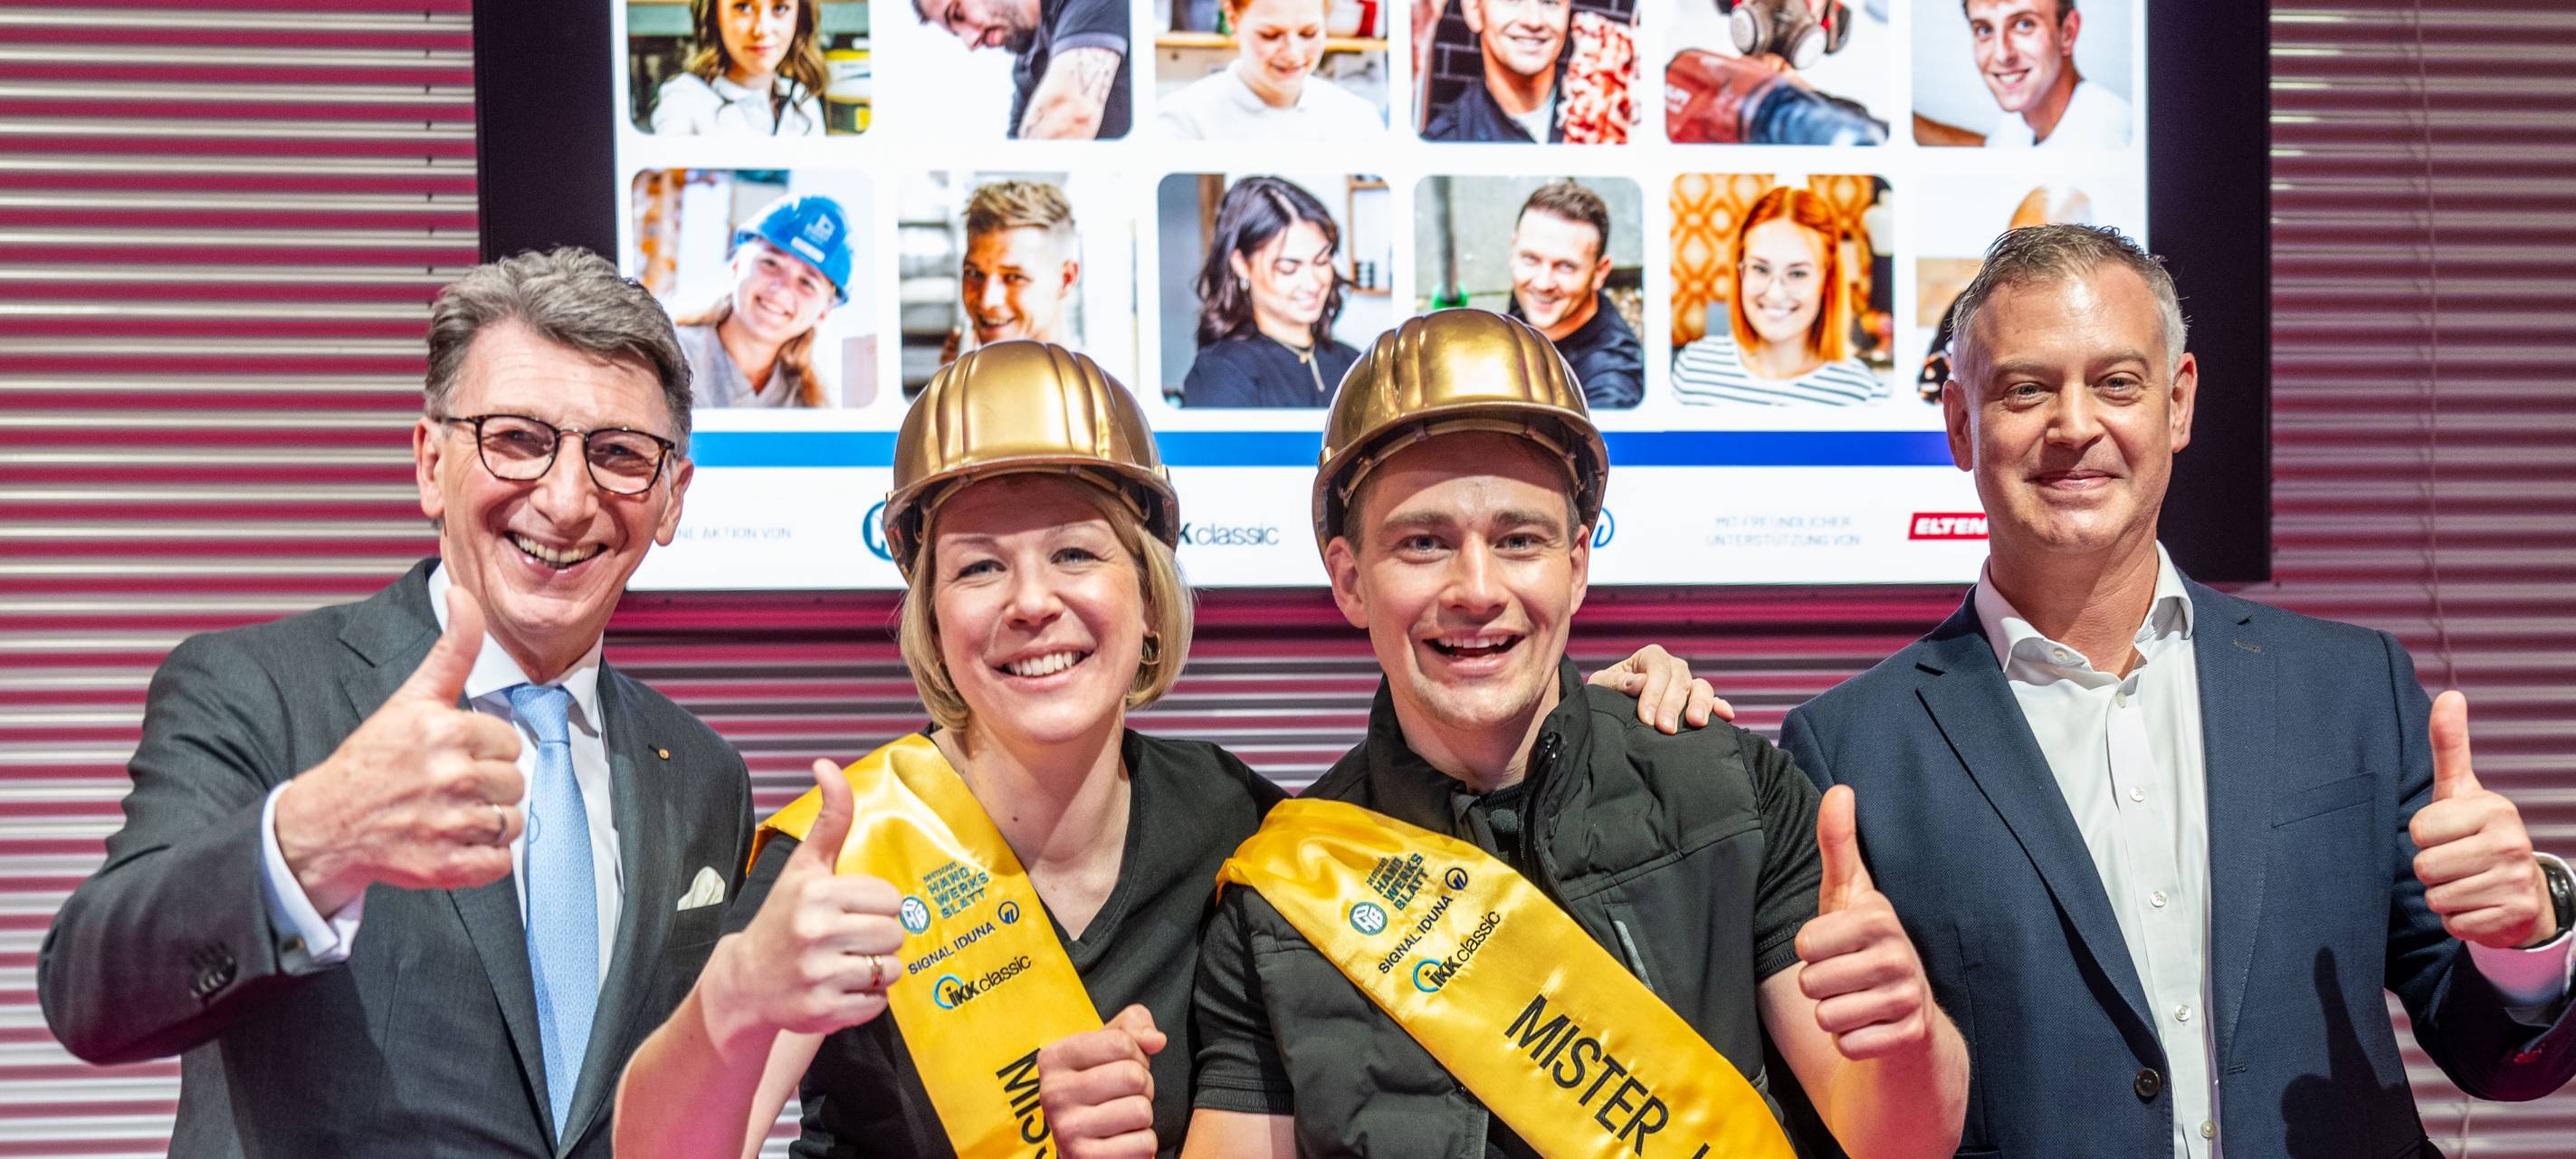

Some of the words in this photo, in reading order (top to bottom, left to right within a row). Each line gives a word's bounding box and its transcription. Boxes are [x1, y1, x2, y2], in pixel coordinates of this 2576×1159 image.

[702, 528, 757, 539] AKTION
[761, 528, 791, 539] VON
[1196, 522, 1280, 545] classic
[1914, 517, 1989, 535] ELTEN
[927, 867, 970, 895] HAND
[933, 872, 988, 905] WERKS
[1373, 857, 1404, 895] HAND
[1383, 853, 1424, 902] WERKS
[1394, 867, 1428, 911] BLATT
[940, 887, 985, 919] BLATT
[908, 946, 954, 974] SIGNAL
[953, 922, 996, 951] IDUNA
[1379, 934, 1422, 974] SIGNAL
[1417, 896, 1454, 934] IDUNA
[1456, 911, 1501, 963] classic
[979, 956, 1031, 991] classic
[1504, 994, 1669, 1156] MISTER
[997, 1048, 1052, 1159] MIS
